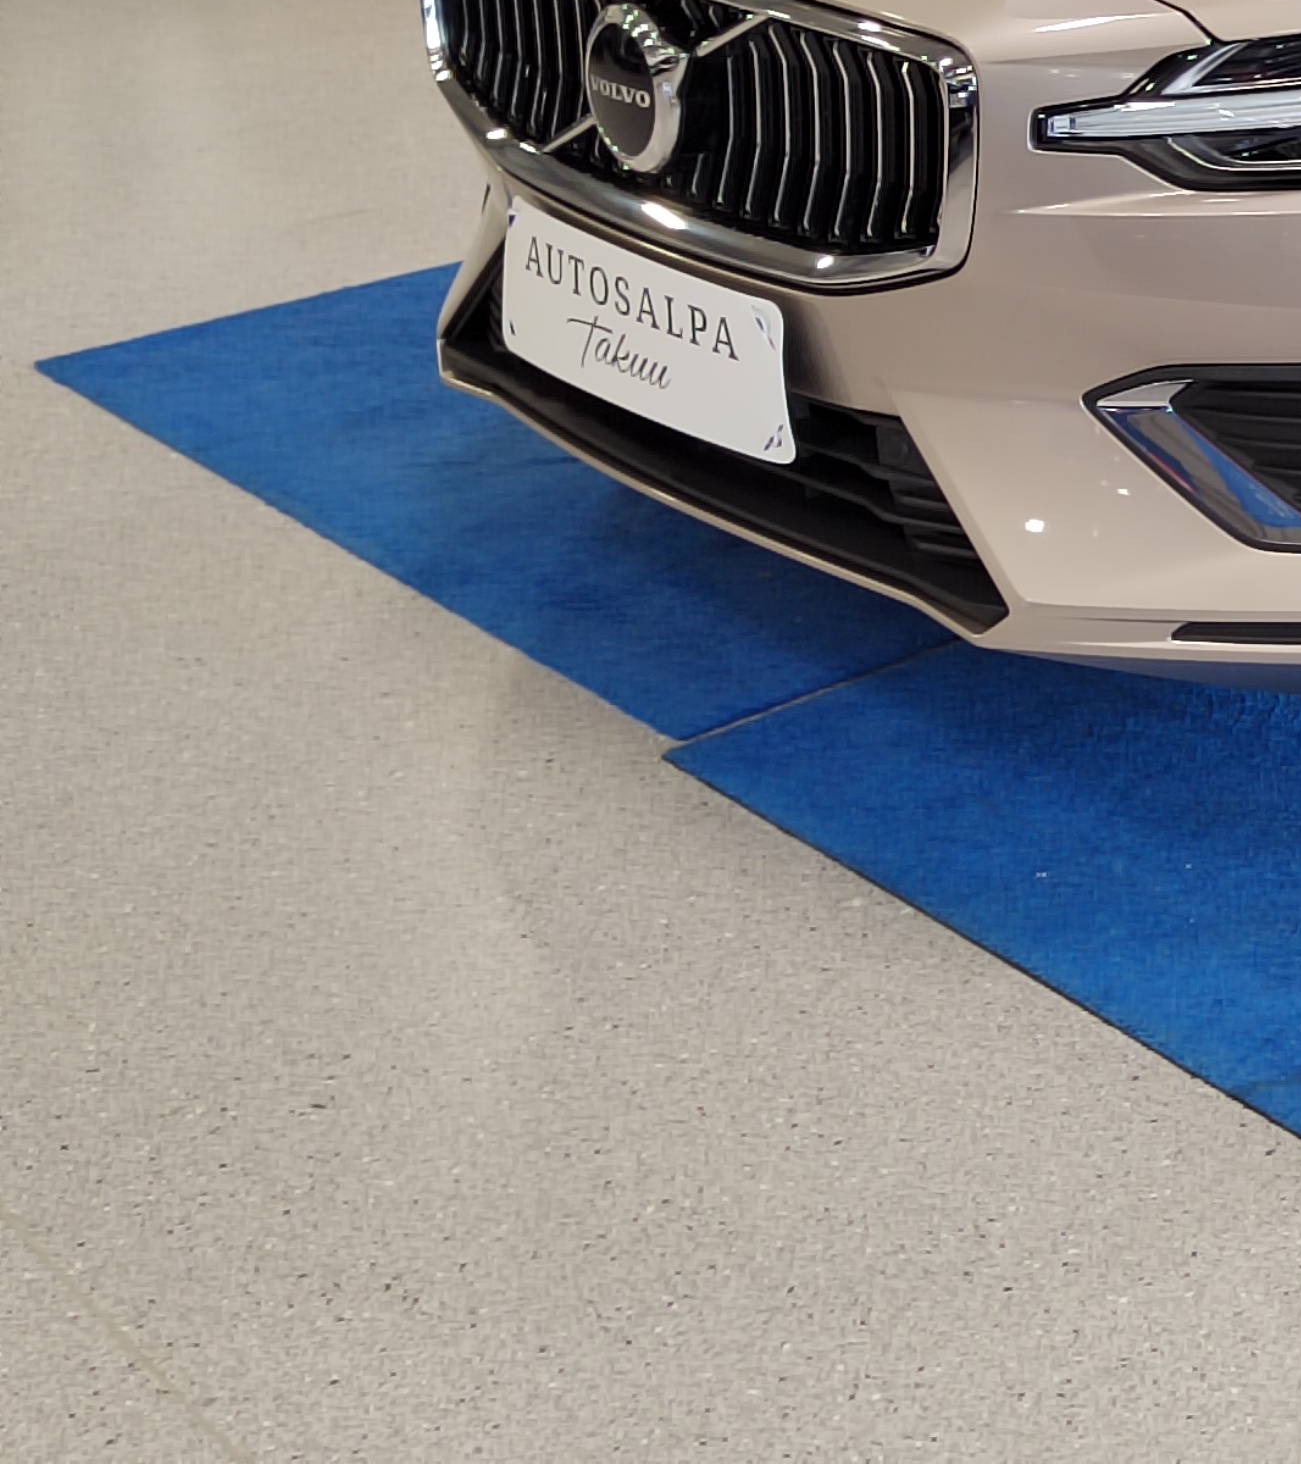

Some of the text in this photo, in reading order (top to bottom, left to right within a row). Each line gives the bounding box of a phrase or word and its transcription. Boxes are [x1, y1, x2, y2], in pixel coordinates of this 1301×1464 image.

[590, 73, 651, 108] VOLVO
[525, 236, 739, 361] AUTOSALPA
[566, 314, 672, 390] Takuu
